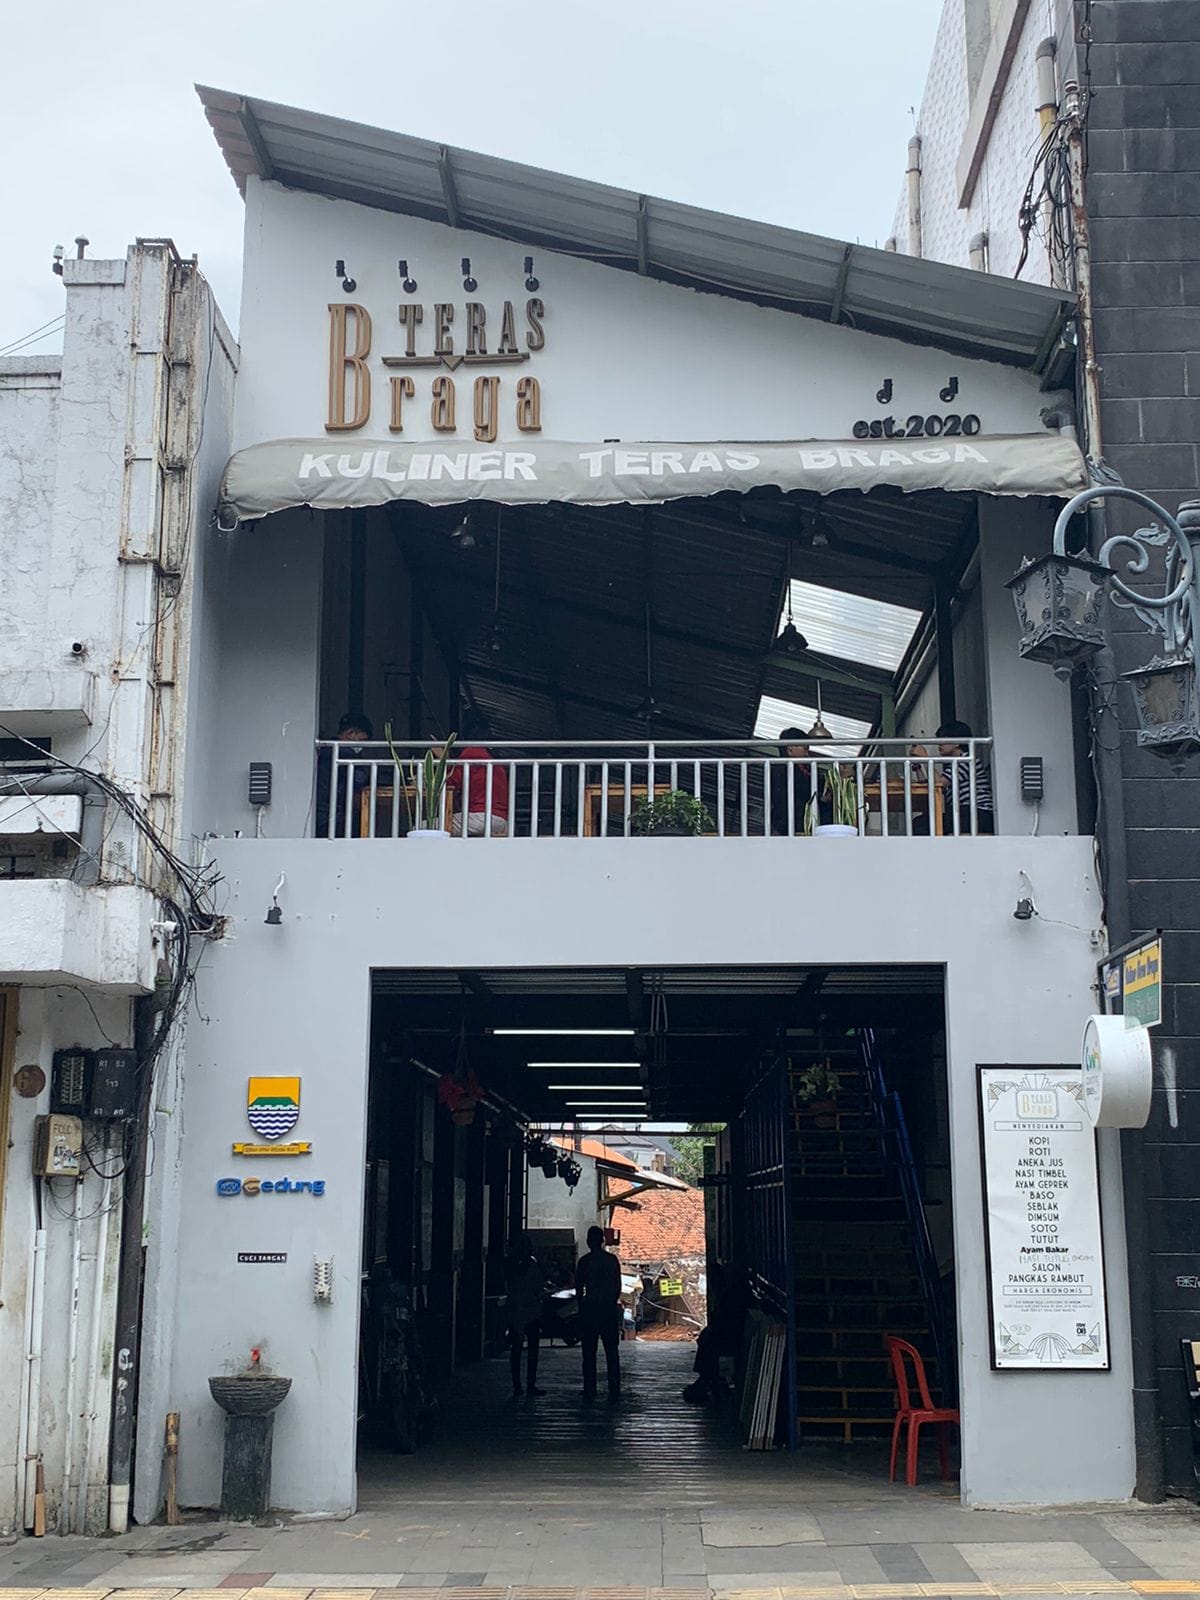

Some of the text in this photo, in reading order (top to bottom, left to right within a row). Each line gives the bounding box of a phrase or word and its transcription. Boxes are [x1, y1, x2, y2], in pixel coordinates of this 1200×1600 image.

[399, 298, 546, 358] TERAS
[324, 303, 543, 443] Braga
[852, 414, 981, 438] est.2020
[299, 443, 989, 482] KULINER TERAS BRAGA
[1028, 1136, 1050, 1145] KOPI
[1028, 1147, 1051, 1156] ROTI
[1017, 1158, 1064, 1167] ANEKA JUS
[1015, 1169, 1067, 1178] NASI TIMBEL
[242, 1176, 326, 1197] Gedung
[1015, 1180, 1069, 1189] AYAM GEPREK
[1029, 1191, 1055, 1200] BASO
[1027, 1202, 1059, 1211] SEBLAK
[1027, 1213, 1060, 1222] DIMSUM
[1030, 1224, 1058, 1233] SOTO
[1030, 1235, 1059, 1244] TUTUT
[1020, 1246, 1044, 1254] Ayam
[1031, 1263, 1061, 1272] SALON
[1008, 1274, 1085, 1283] PANGKAS RAMBUT
